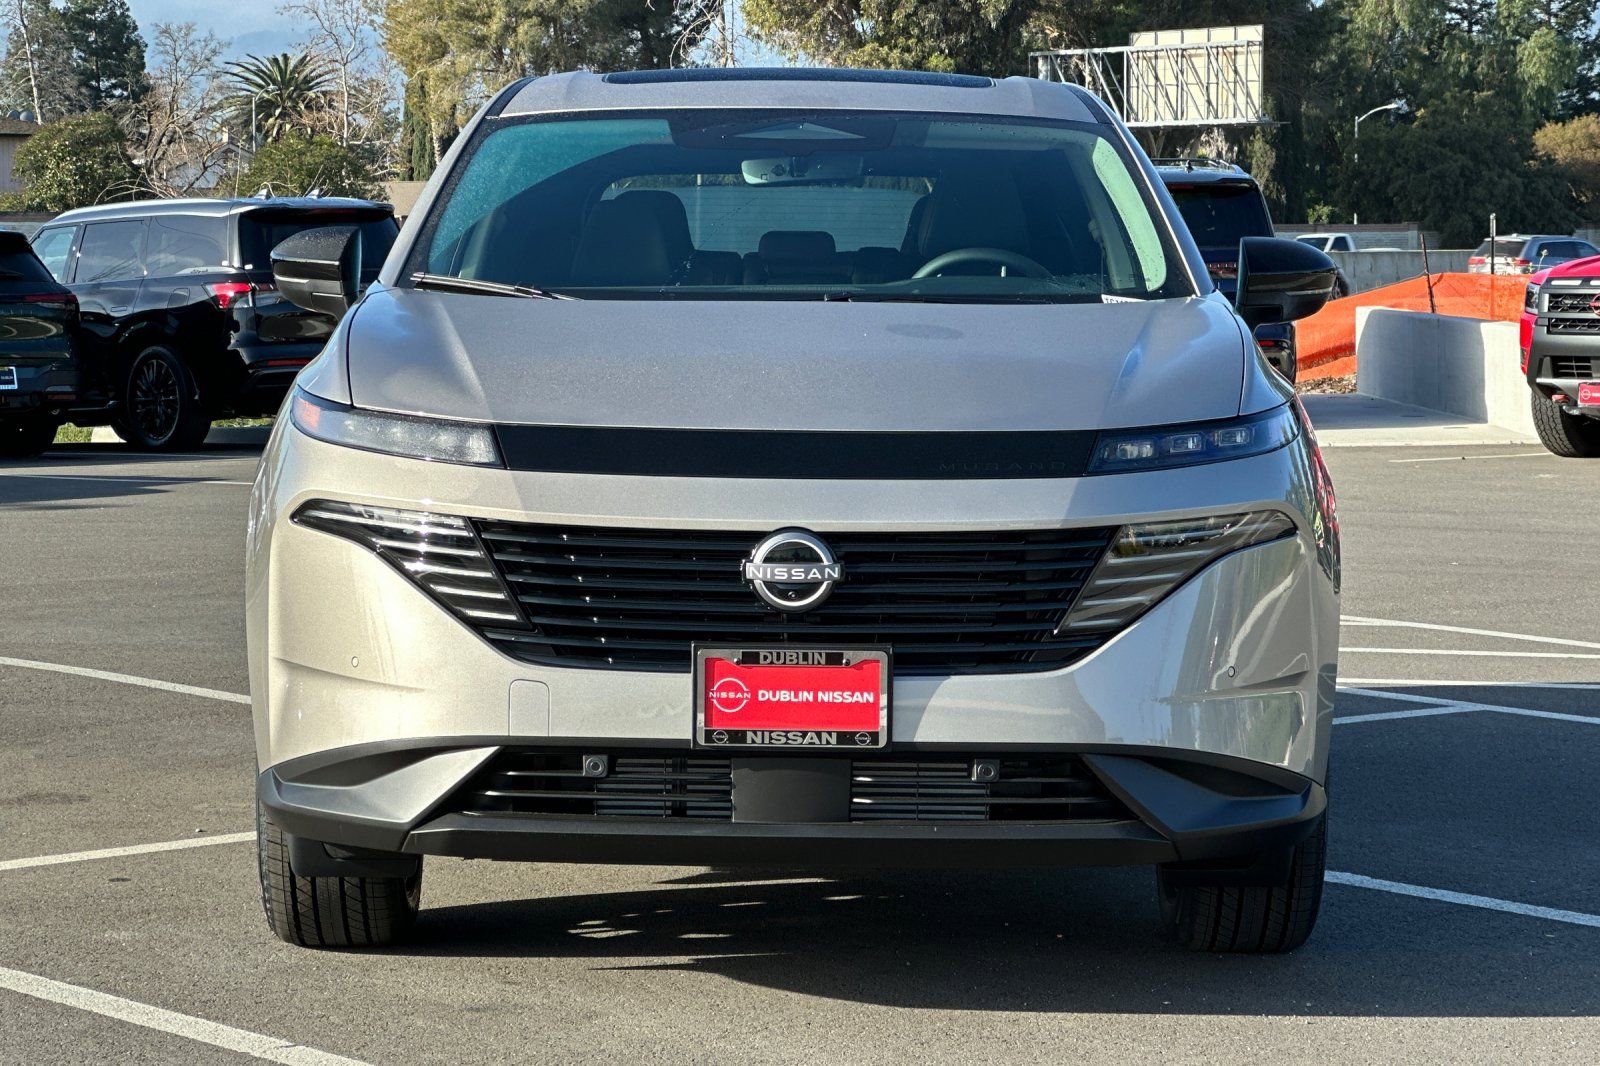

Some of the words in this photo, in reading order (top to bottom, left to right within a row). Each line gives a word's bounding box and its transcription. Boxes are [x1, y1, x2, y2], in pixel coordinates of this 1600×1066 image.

[939, 462, 1066, 471] MURANO
[749, 566, 839, 580] NISSAN
[759, 651, 826, 665] DUBLIN
[709, 691, 751, 699] NISSAN
[758, 690, 814, 702] DUBLIN
[818, 691, 874, 704] NISSAN
[746, 731, 837, 745] NISSAN
